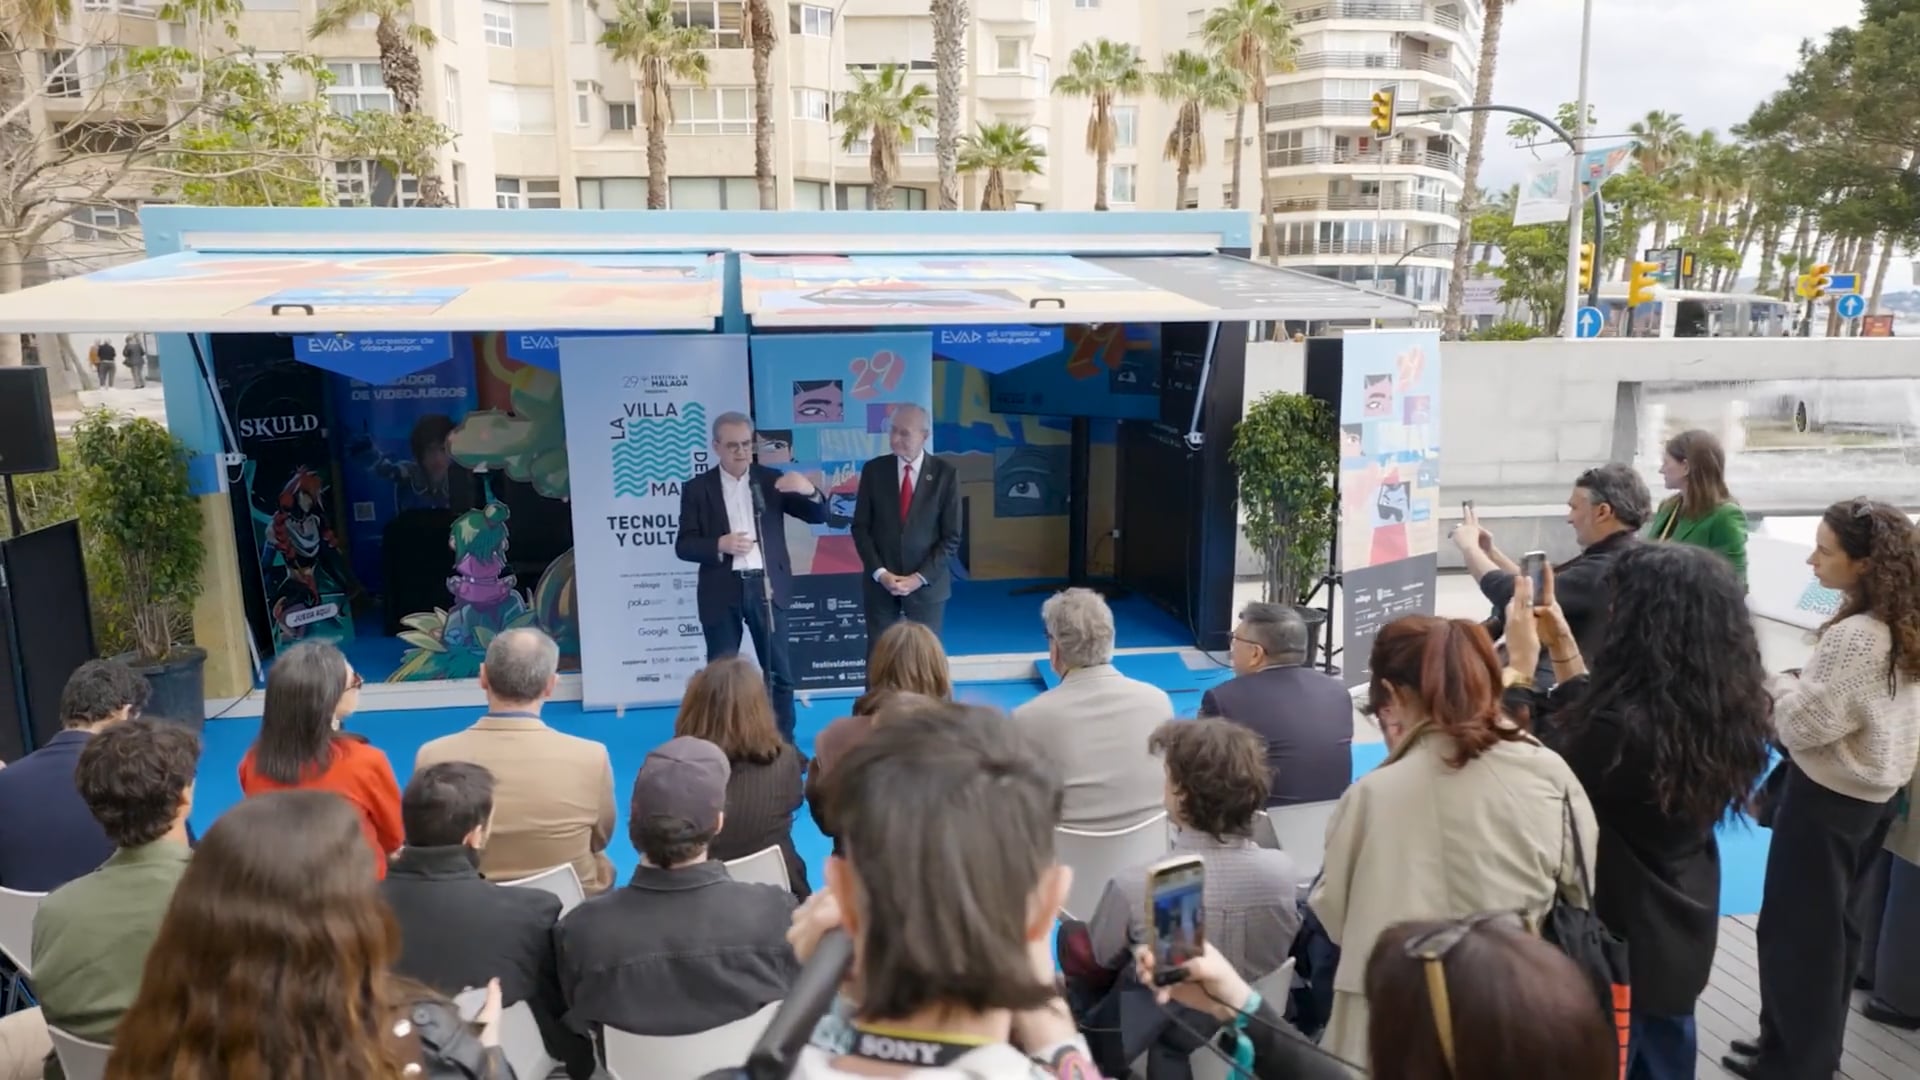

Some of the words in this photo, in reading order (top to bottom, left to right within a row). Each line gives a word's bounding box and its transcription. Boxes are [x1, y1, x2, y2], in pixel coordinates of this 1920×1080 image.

[850, 350, 903, 398] 29
[623, 402, 679, 418] VILLA
[240, 414, 319, 438] SKULD
[610, 417, 626, 440] LA
[694, 451, 709, 476] DE
[651, 482, 681, 497] MA
[606, 514, 682, 531] TECNOL
[615, 533, 627, 547] Y
[632, 530, 679, 547] CULT
[638, 626, 669, 638] Google
[860, 1033, 942, 1065] SONY
